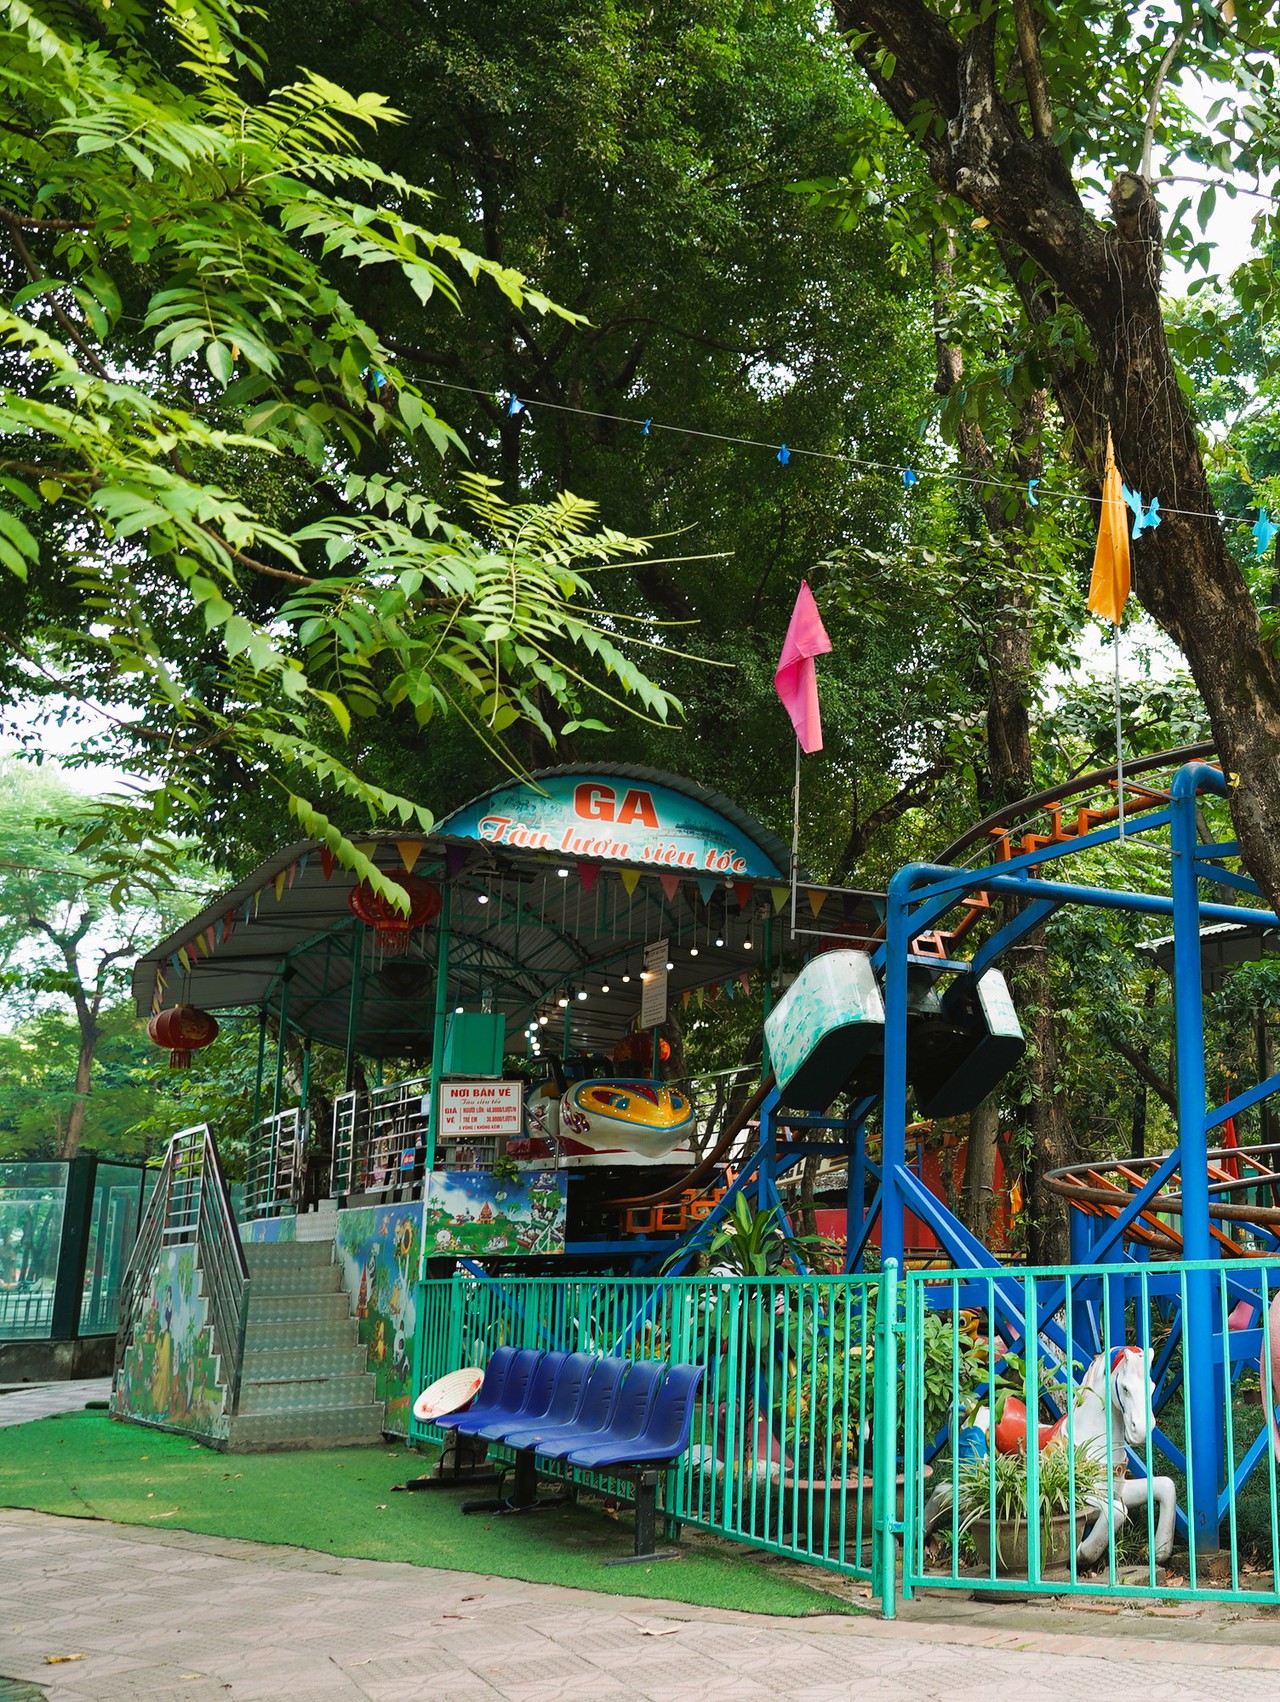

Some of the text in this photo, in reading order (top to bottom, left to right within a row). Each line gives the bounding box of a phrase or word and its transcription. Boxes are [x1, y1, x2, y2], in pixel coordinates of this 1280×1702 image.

[574, 782, 660, 829] GA
[478, 816, 548, 846] Tàu
[641, 843, 697, 866] siêu
[705, 848, 747, 872] tốc
[450, 1087, 511, 1097] NƠI BÁN VÉ
